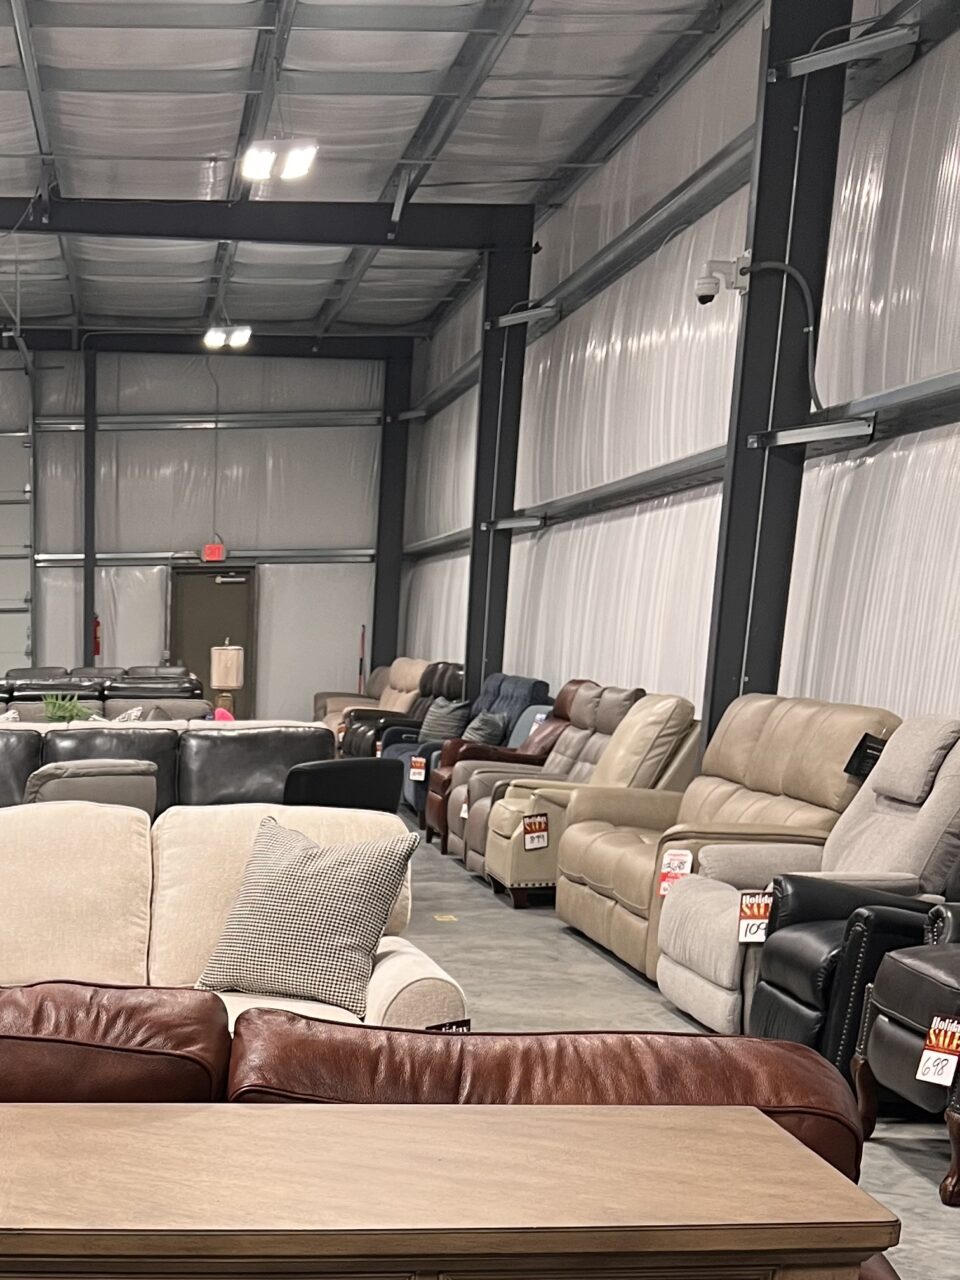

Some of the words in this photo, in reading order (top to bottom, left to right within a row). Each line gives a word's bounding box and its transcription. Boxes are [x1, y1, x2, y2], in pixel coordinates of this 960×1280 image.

[742, 894, 773, 904] Holida
[931, 1016, 960, 1034] Holida
[921, 1056, 949, 1076] 698
